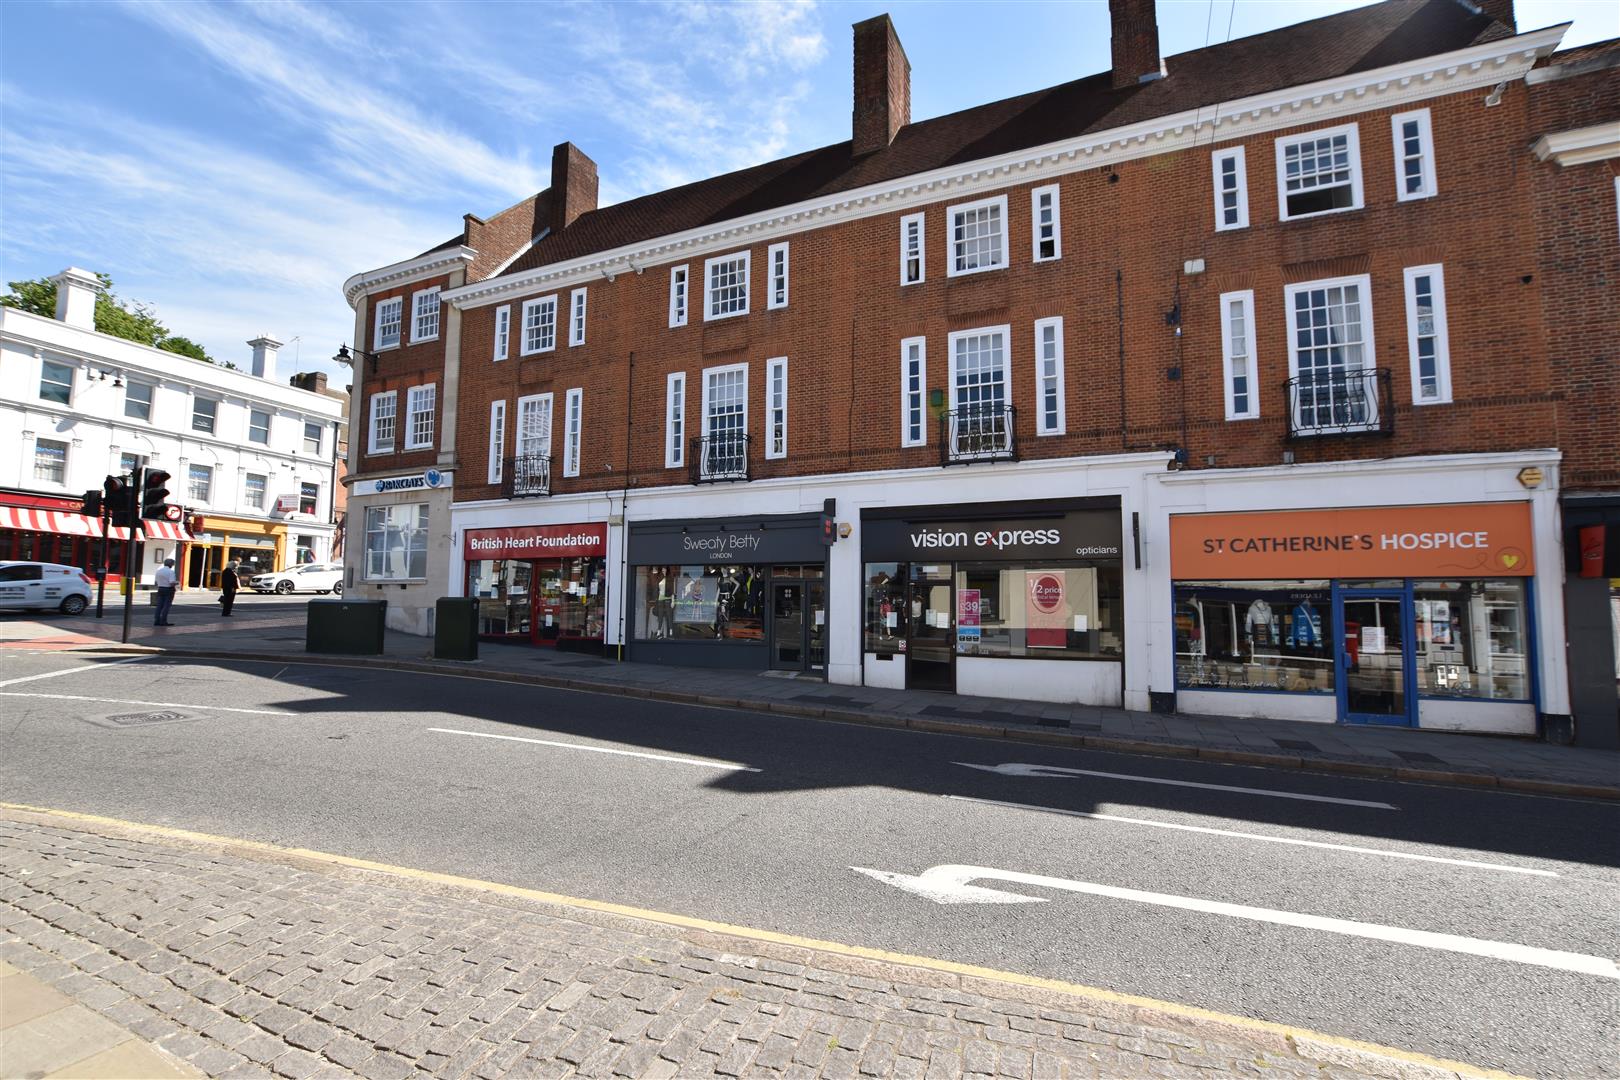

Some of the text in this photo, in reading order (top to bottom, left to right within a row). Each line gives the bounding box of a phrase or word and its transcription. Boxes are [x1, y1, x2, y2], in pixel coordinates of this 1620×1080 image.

[471, 533, 600, 550] British Heart Foundation
[684, 534, 760, 552] Sweaty Betty
[910, 526, 1061, 550] vision express
[1229, 534, 1373, 553] CATHERINE'S
[1381, 531, 1489, 550] HOSPICE
[1075, 545, 1118, 555] opticians
